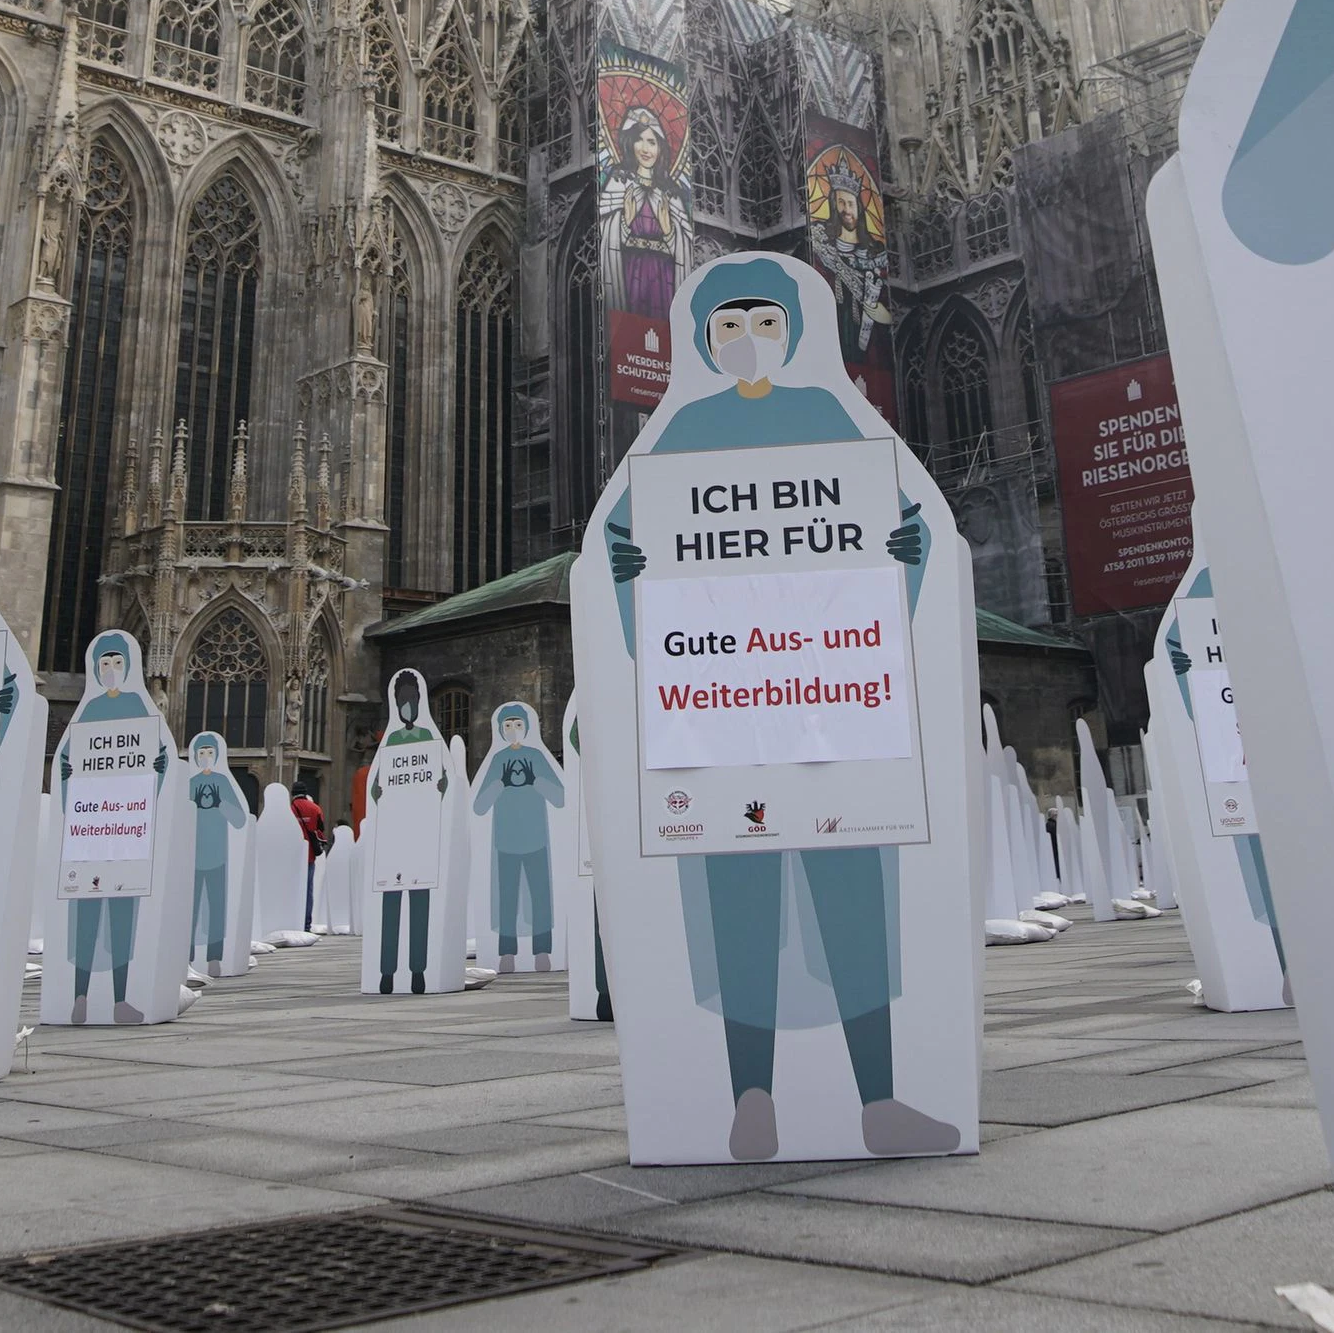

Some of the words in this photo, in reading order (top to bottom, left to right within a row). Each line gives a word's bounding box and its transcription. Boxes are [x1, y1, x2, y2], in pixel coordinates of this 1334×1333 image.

[626, 353, 664, 370] WERDEN
[1099, 404, 1178, 437] SPENDEN
[1094, 442, 1120, 461] SIE
[1123, 431, 1157, 455] FÜR
[691, 483, 758, 514] ICH
[772, 478, 841, 509] BIN
[1110, 499, 1143, 513] RETTEN
[1144, 495, 1161, 506] WIR
[1162, 490, 1187, 503] JETZT
[676, 529, 770, 562] HIER
[783, 517, 864, 555] FÜR
[664, 631, 737, 656] Gute
[746, 627, 813, 653] Aus-
[823, 620, 881, 649] und
[659, 673, 892, 710] Weiterbildung!
[89, 736, 112, 750] ICH
[117, 734, 140, 748] BIN
[82, 756, 114, 771] HIER
[119, 752, 146, 769] FÜR
[392, 757, 409, 768] ICH
[412, 754, 428, 766] BIN
[388, 774, 410, 787] HIER
[413, 769, 433, 783] FÜR
[74, 801, 99, 813] Gute
[101, 800, 124, 812] Aus-
[127, 798, 147, 811] und
[70, 823, 147, 838] Weiterbildung!
[658, 823, 704, 835] younion
